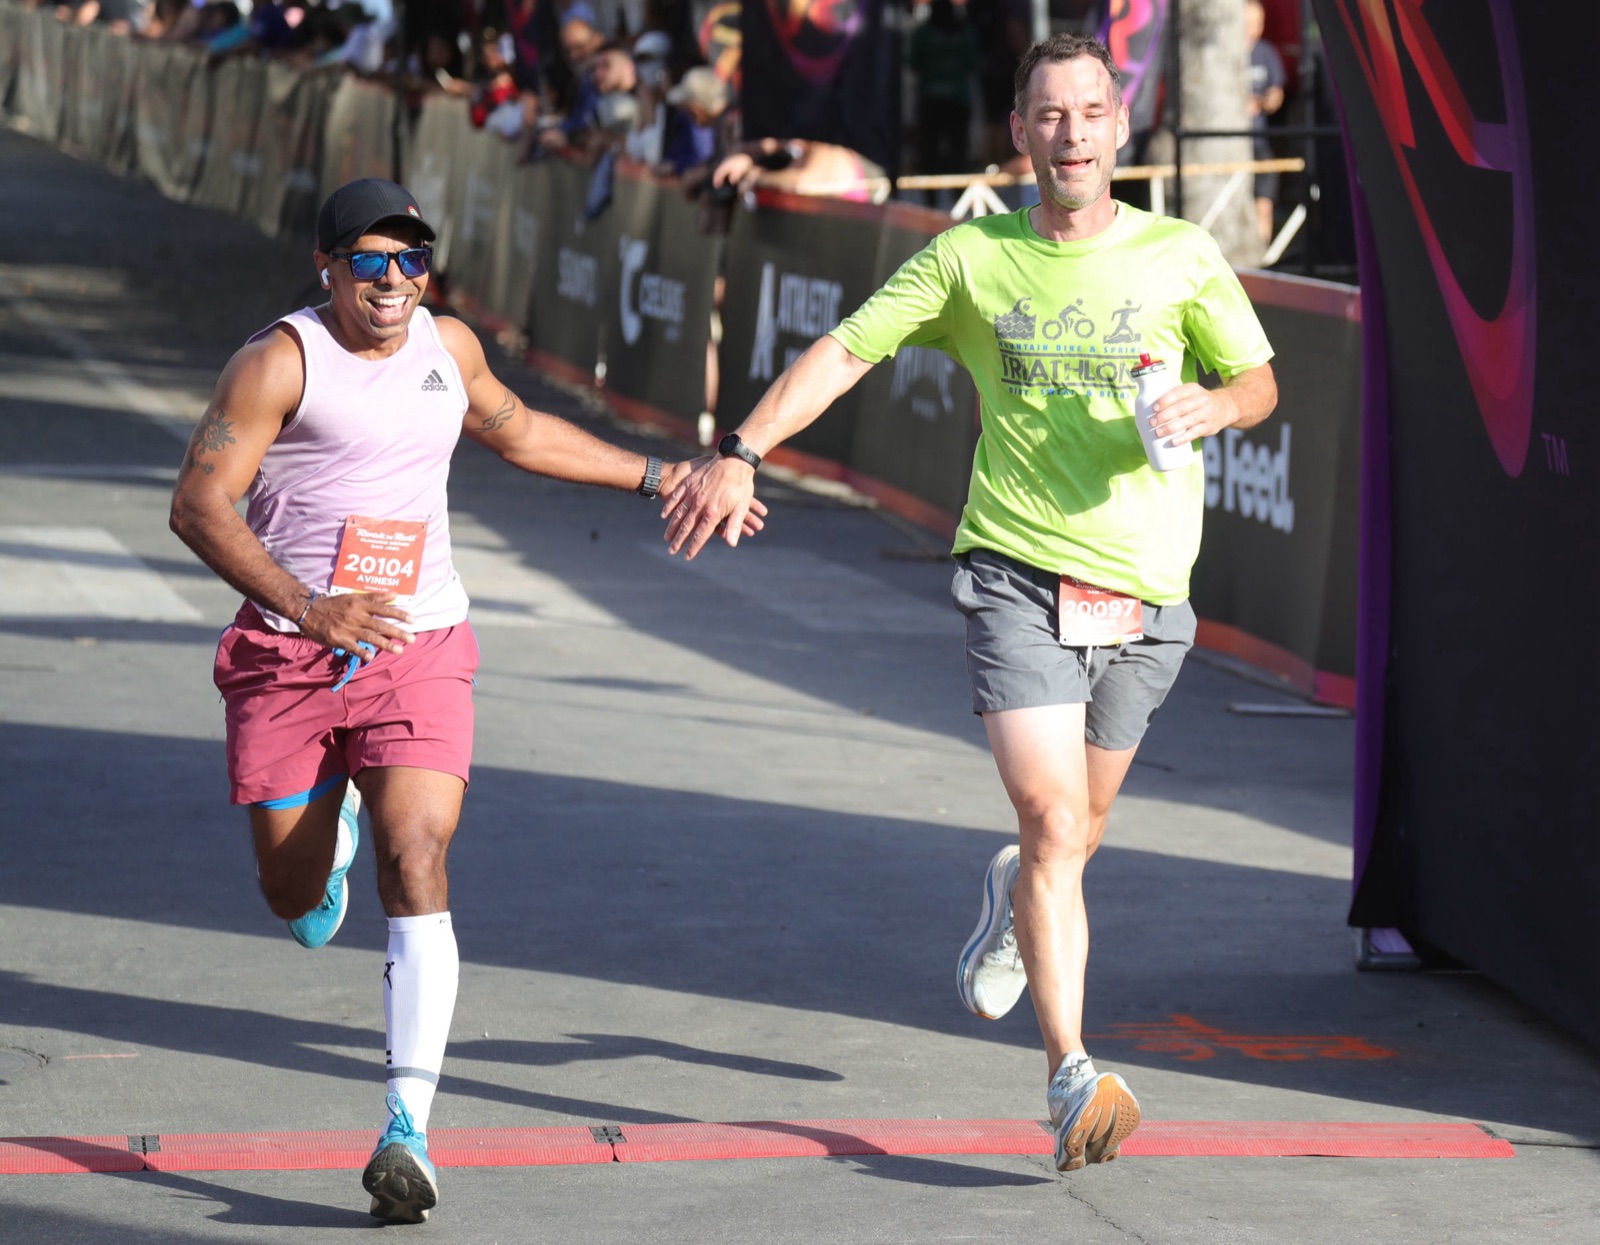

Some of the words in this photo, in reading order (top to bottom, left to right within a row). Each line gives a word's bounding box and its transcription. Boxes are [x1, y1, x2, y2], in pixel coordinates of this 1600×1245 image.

[997, 341, 1049, 351] MOUNTAIN
[1056, 344, 1083, 352] BIKE
[1000, 354, 1137, 383] TRIATHLON
[421, 384, 449, 392] adidas
[1540, 432, 1571, 478] TM
[344, 554, 414, 578] 20104
[357, 574, 400, 586] AVINESH
[1064, 599, 1137, 618] 20097
